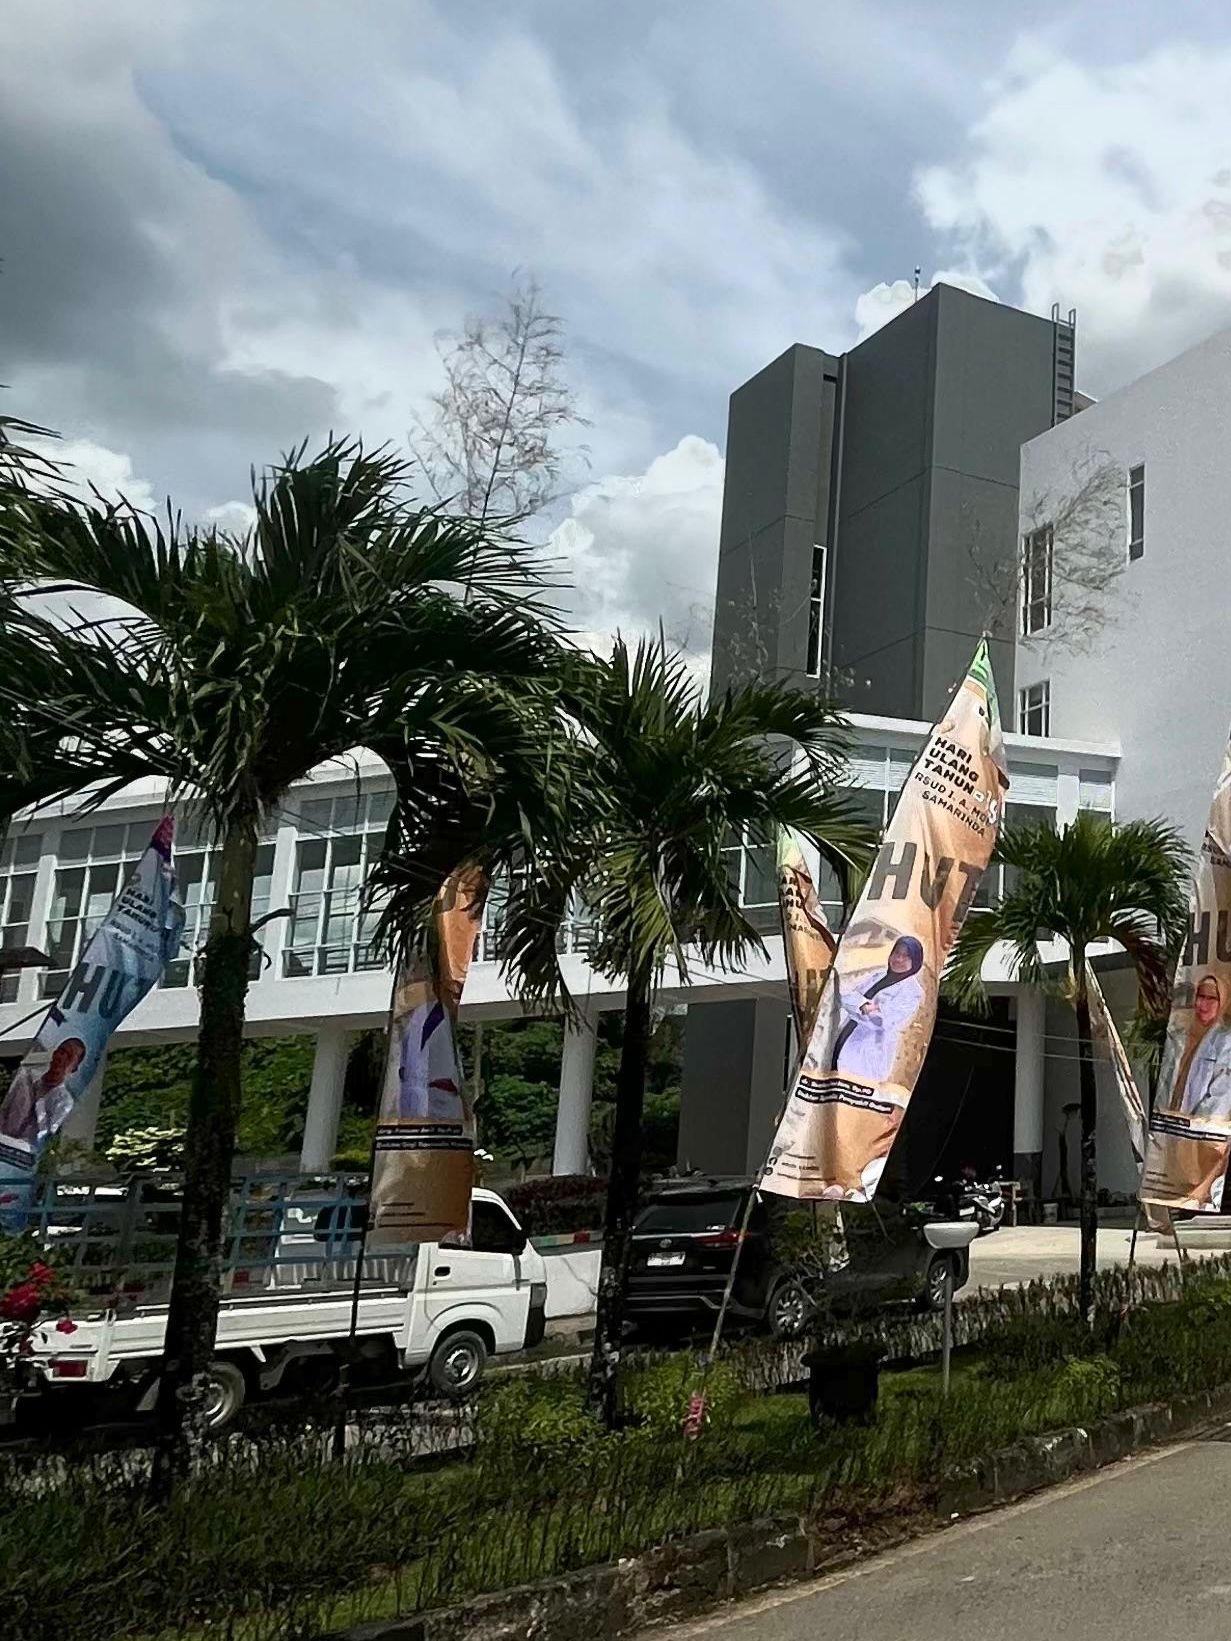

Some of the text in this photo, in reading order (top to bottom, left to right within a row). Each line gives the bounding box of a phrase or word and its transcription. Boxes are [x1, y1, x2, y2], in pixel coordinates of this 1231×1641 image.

[929, 748, 979, 782] ULANG
[935, 737, 972, 763] HARI
[915, 772, 947, 794] RSUD
[924, 758, 974, 795] TAHUN
[922, 790, 985, 837] SAMARINDA
[867, 841, 984, 922] HUT
